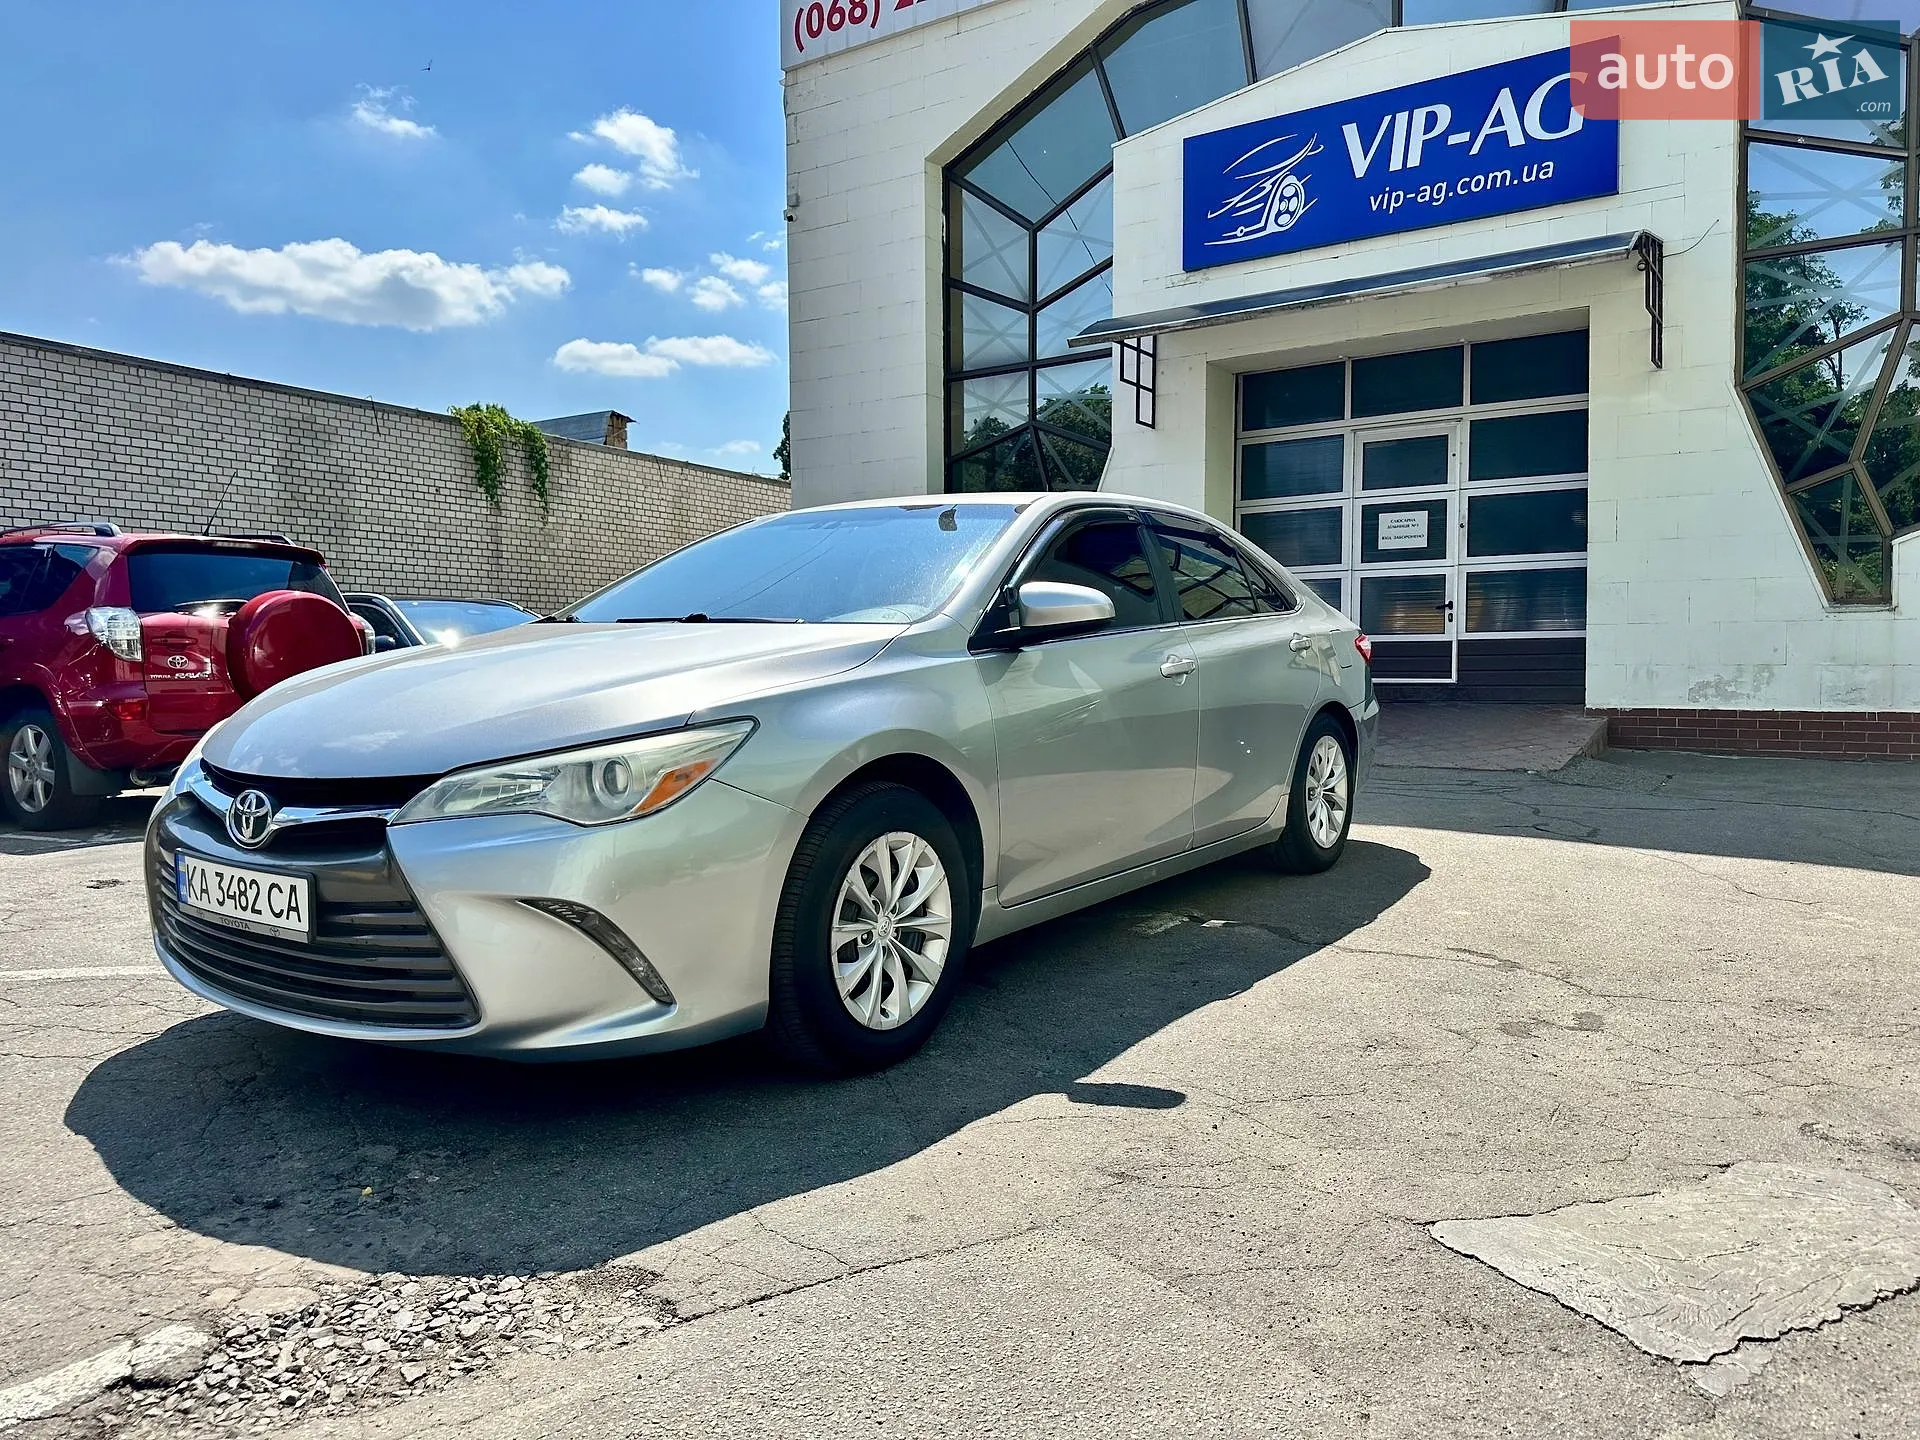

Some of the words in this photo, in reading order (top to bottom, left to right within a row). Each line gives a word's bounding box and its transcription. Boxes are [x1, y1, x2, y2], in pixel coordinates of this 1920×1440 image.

[795, 0, 880, 52] (068)
[1341, 71, 1589, 179] VIP-AG
[1369, 160, 1556, 214] vip-ag.com.ua
[186, 863, 211, 904] KA
[215, 871, 262, 915] 3482
[267, 882, 302, 923] CA
[219, 916, 250, 930] TOYOTA
